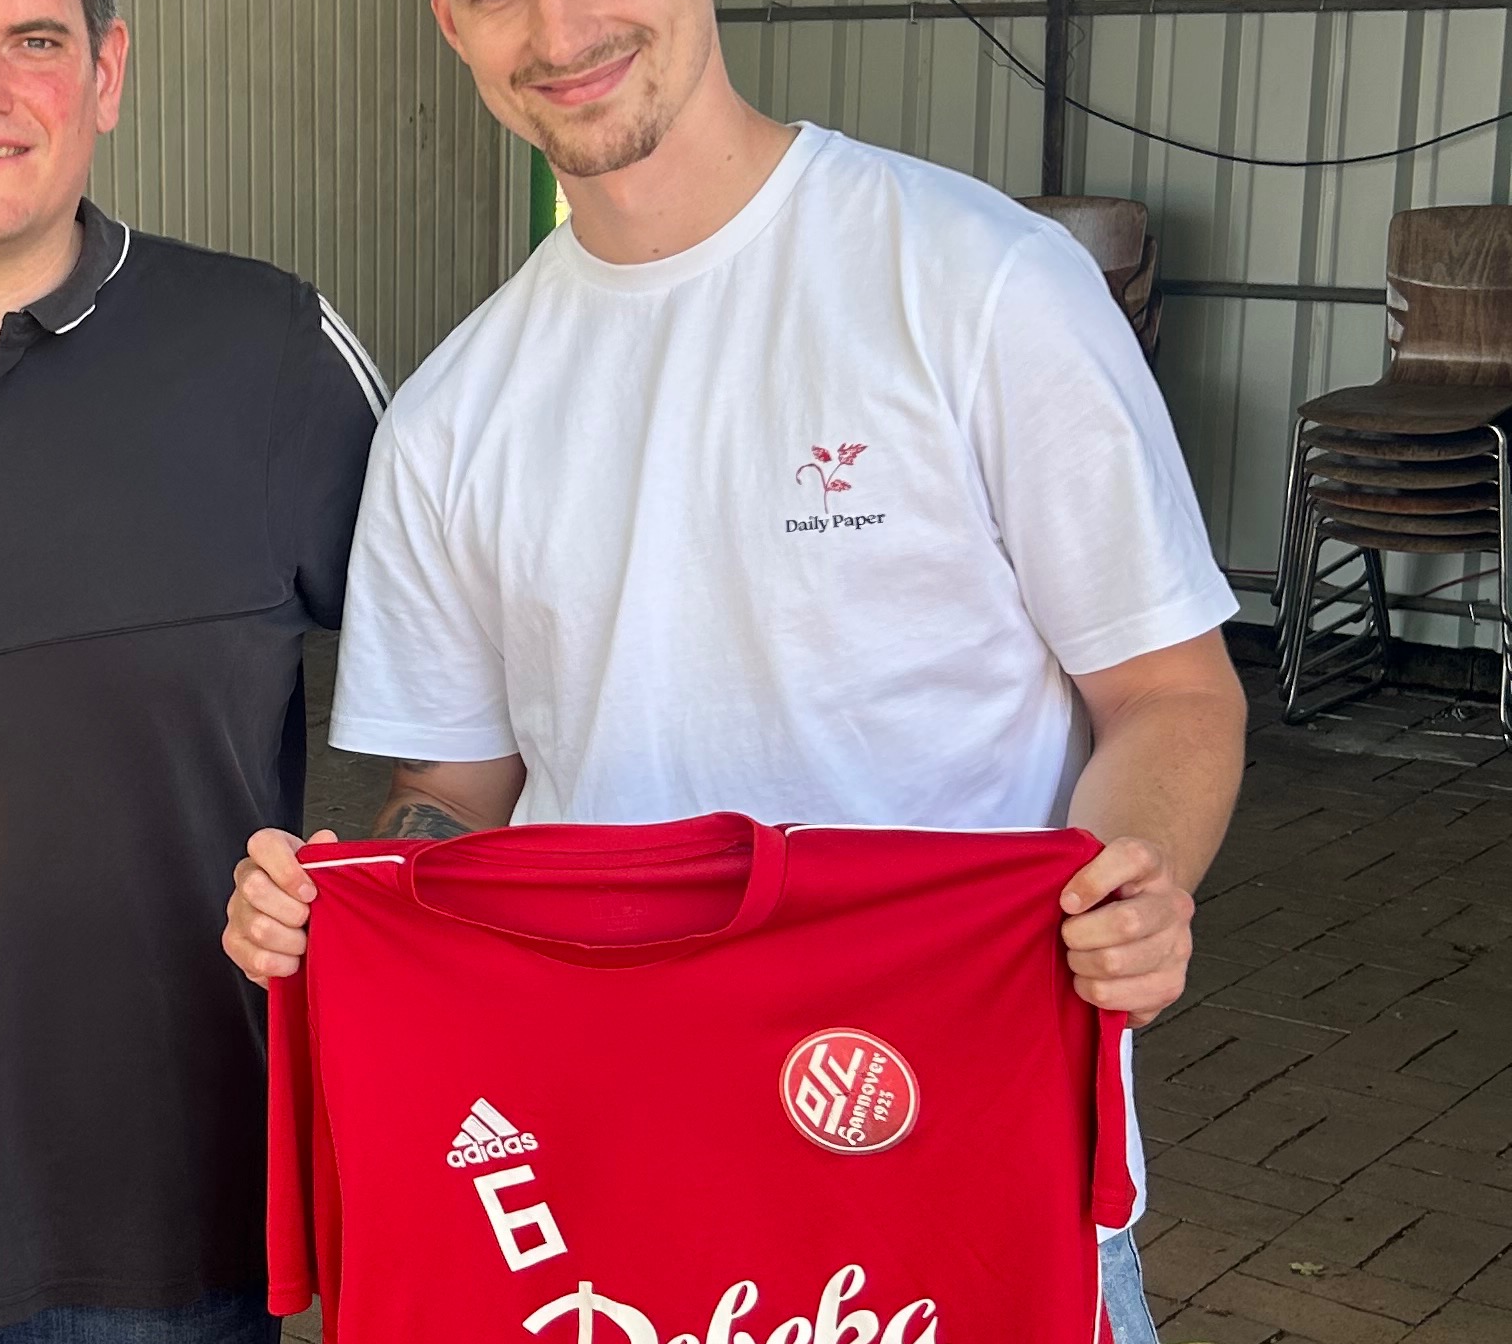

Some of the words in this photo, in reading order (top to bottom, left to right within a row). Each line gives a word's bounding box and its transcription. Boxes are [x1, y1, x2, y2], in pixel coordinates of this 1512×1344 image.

[785, 515, 829, 533] Daily
[832, 513, 885, 530] Paper
[873, 1089, 896, 1123] 1923
[446, 1129, 539, 1168] adidas
[473, 1165, 568, 1272] 6
